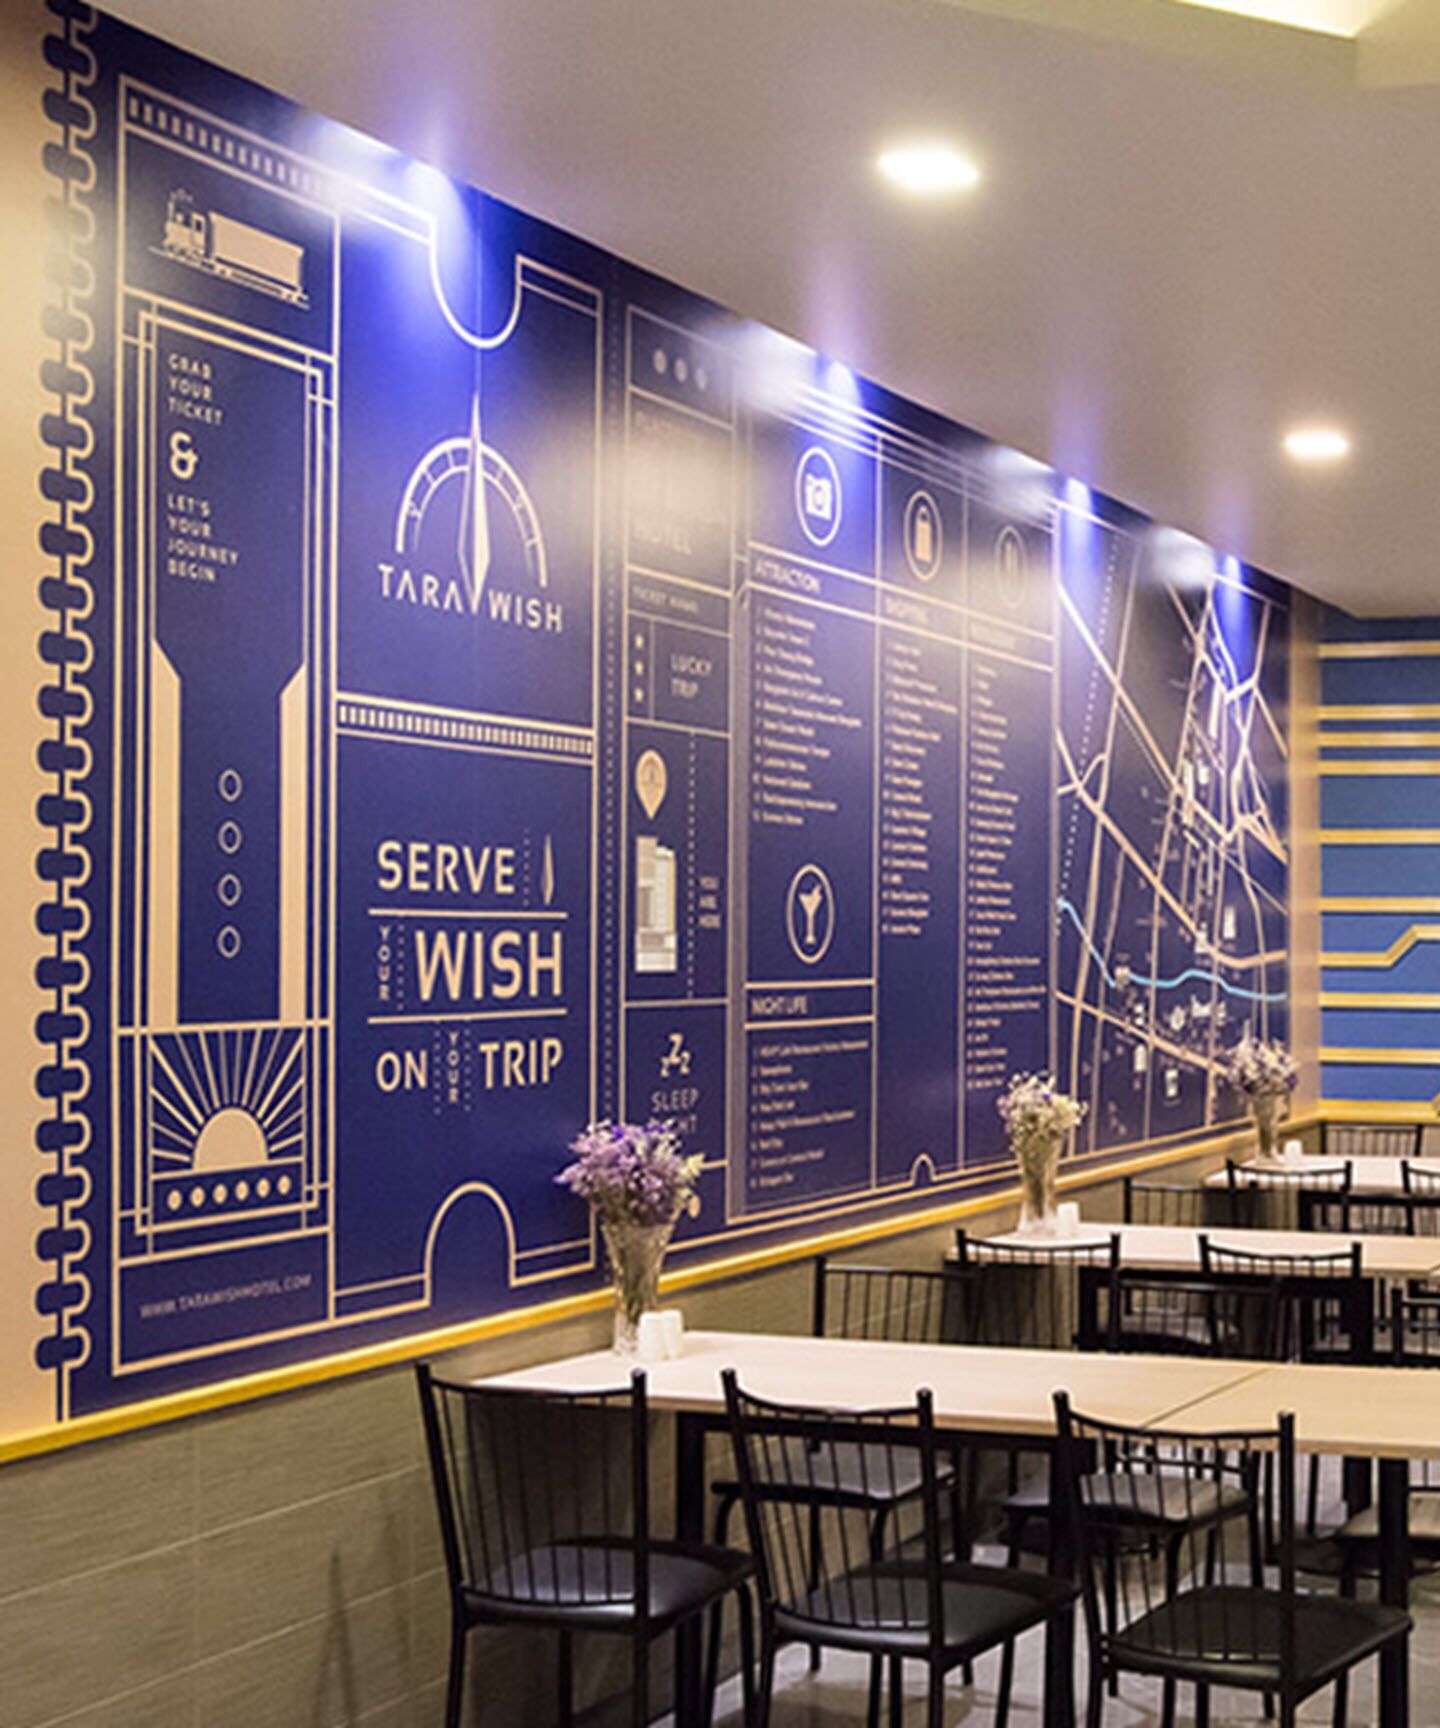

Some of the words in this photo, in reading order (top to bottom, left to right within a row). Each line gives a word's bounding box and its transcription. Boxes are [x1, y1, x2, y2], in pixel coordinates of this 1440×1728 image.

[168, 353, 212, 380] GRAB
[168, 376, 212, 400] YOUR
[168, 396, 222, 425] TICKET
[170, 431, 198, 479] &
[167, 493, 210, 517] LET'S
[167, 514, 210, 539] YOUR
[167, 538, 238, 566] JOURNEY
[168, 558, 215, 582] BEGIN
[378, 562, 464, 614] TARA
[488, 588, 562, 633] WISH
[670, 654, 712, 676] LUCKY
[671, 678, 699, 698] TRIP
[377, 839, 516, 894] SERVE
[378, 925, 391, 1001] YOUR
[415, 930, 561, 1001] WISH
[375, 1050, 428, 1092] ON
[447, 1031, 460, 1103] YOUR
[479, 1037, 563, 1089] TRIP
[651, 1088, 699, 1113] SLEEP
